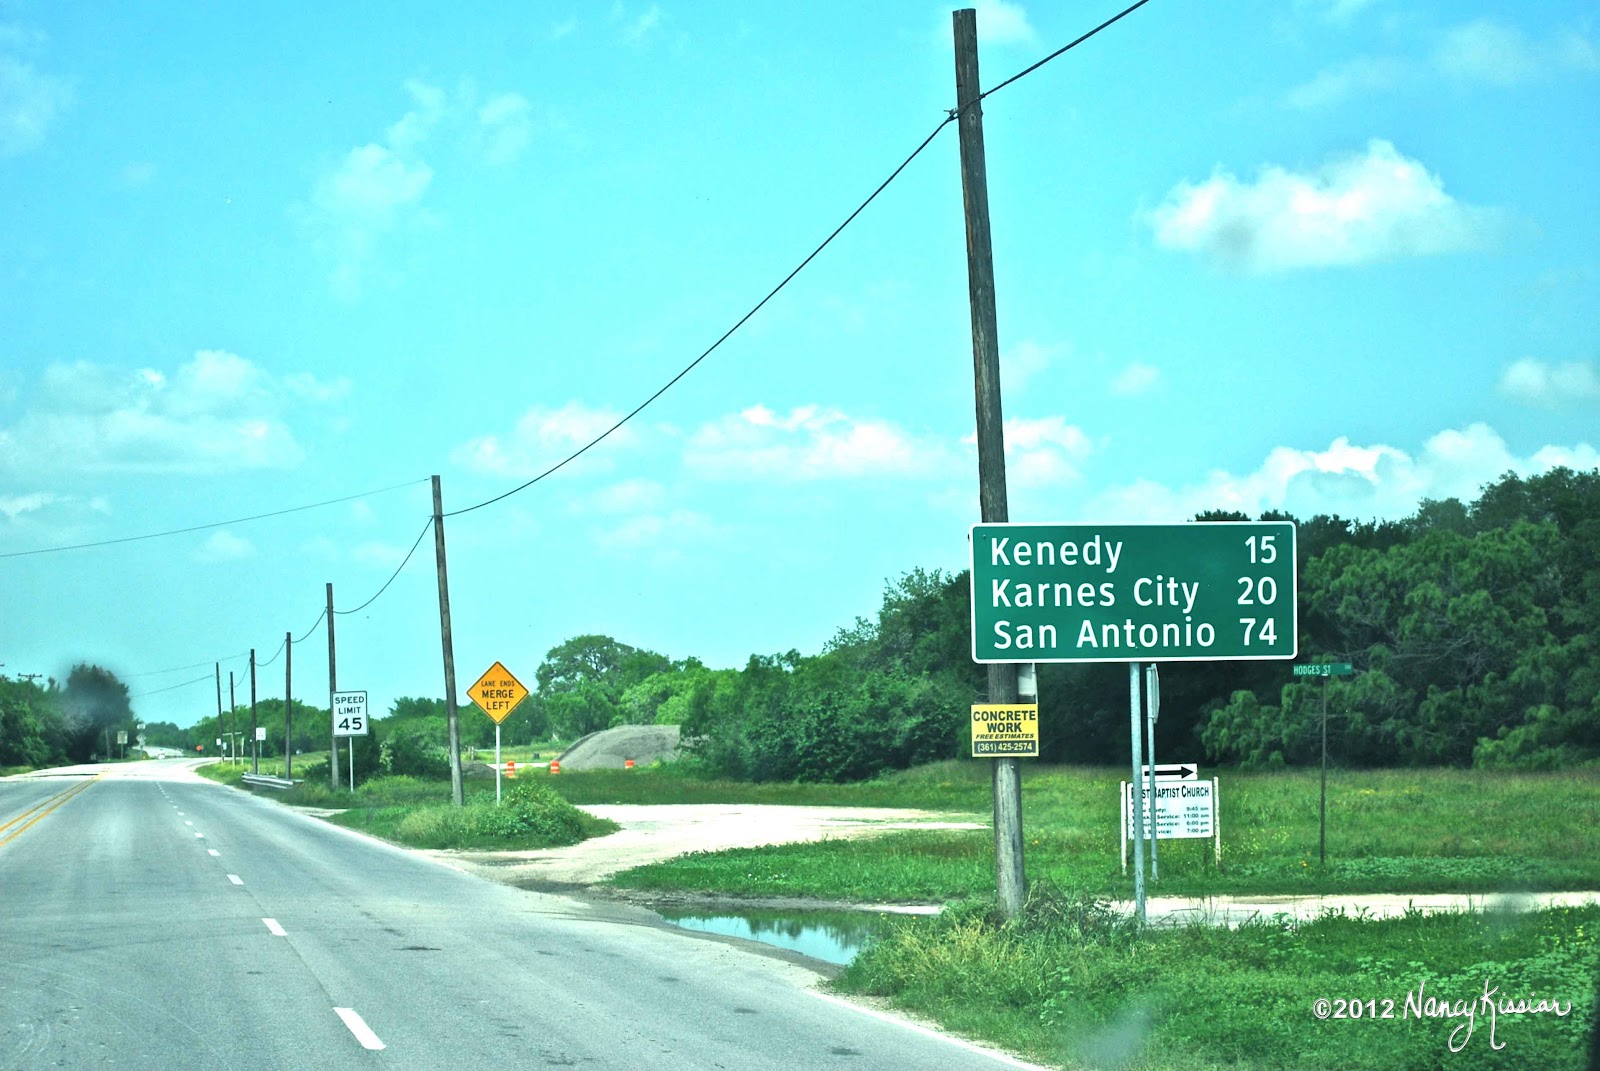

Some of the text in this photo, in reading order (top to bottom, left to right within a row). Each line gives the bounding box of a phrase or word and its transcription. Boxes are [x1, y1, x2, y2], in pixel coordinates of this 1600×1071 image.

[991, 535, 1277, 573] Kenedy 15
[992, 575, 1278, 614] Karnes City 20
[993, 616, 1278, 650] San Antonio 74
[1293, 664, 1331, 675] HODGES ST
[482, 690, 514, 698] MERGE
[335, 696, 364, 704] SPEED
[486, 701, 510, 710] LEFT
[338, 706, 361, 714] LIMIT
[973, 710, 1036, 722] CONCRETE
[338, 717, 362, 730] 45
[987, 722, 1022, 733] WORK
[978, 742, 1032, 752] (361) 425-2574
